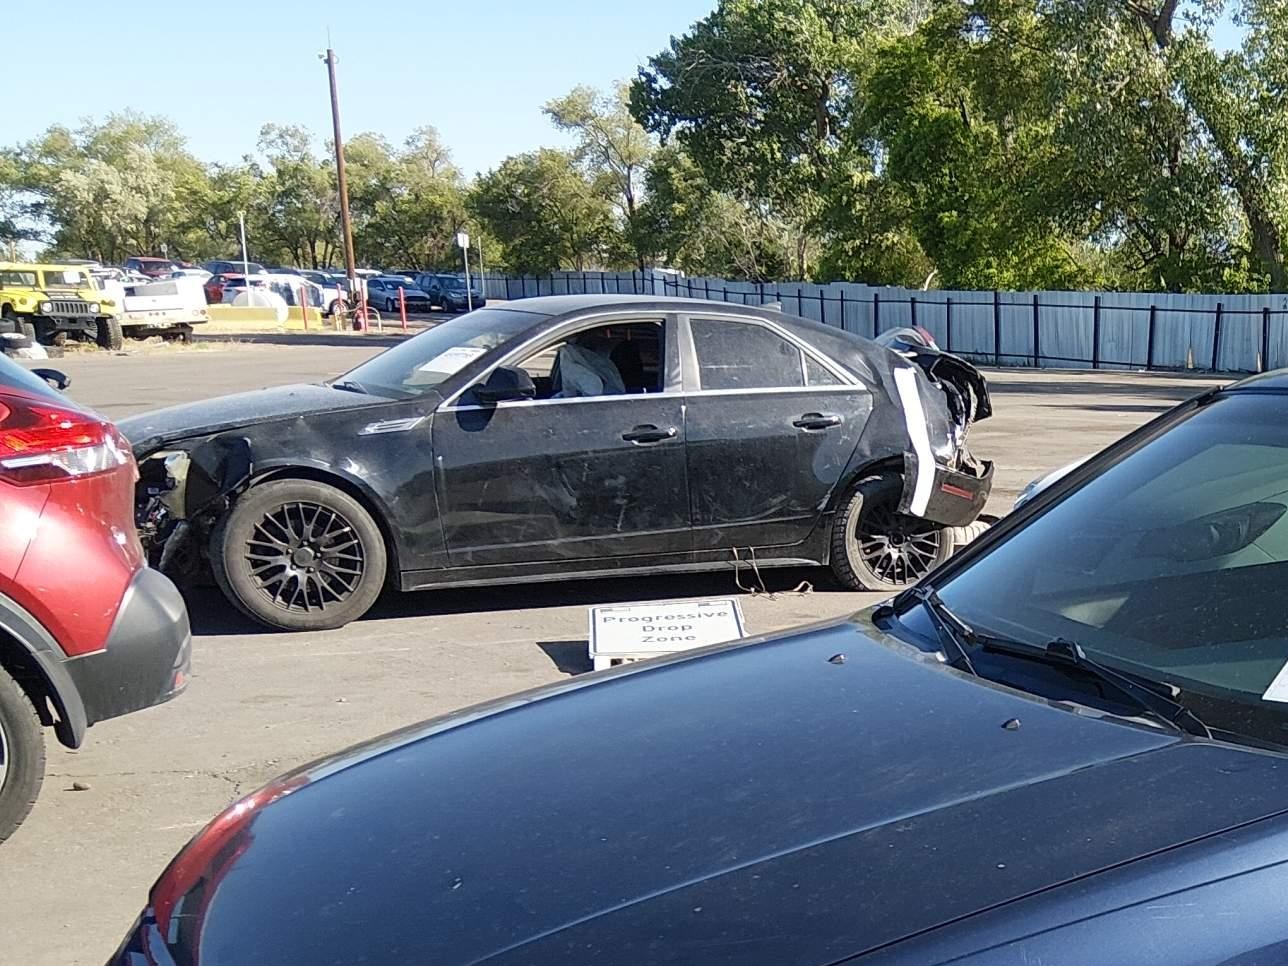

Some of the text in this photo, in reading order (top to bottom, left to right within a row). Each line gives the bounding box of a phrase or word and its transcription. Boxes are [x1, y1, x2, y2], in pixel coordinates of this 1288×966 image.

[603, 610, 729, 623] Progressive
[642, 624, 693, 632] Drop
[641, 635, 697, 643] Zone
